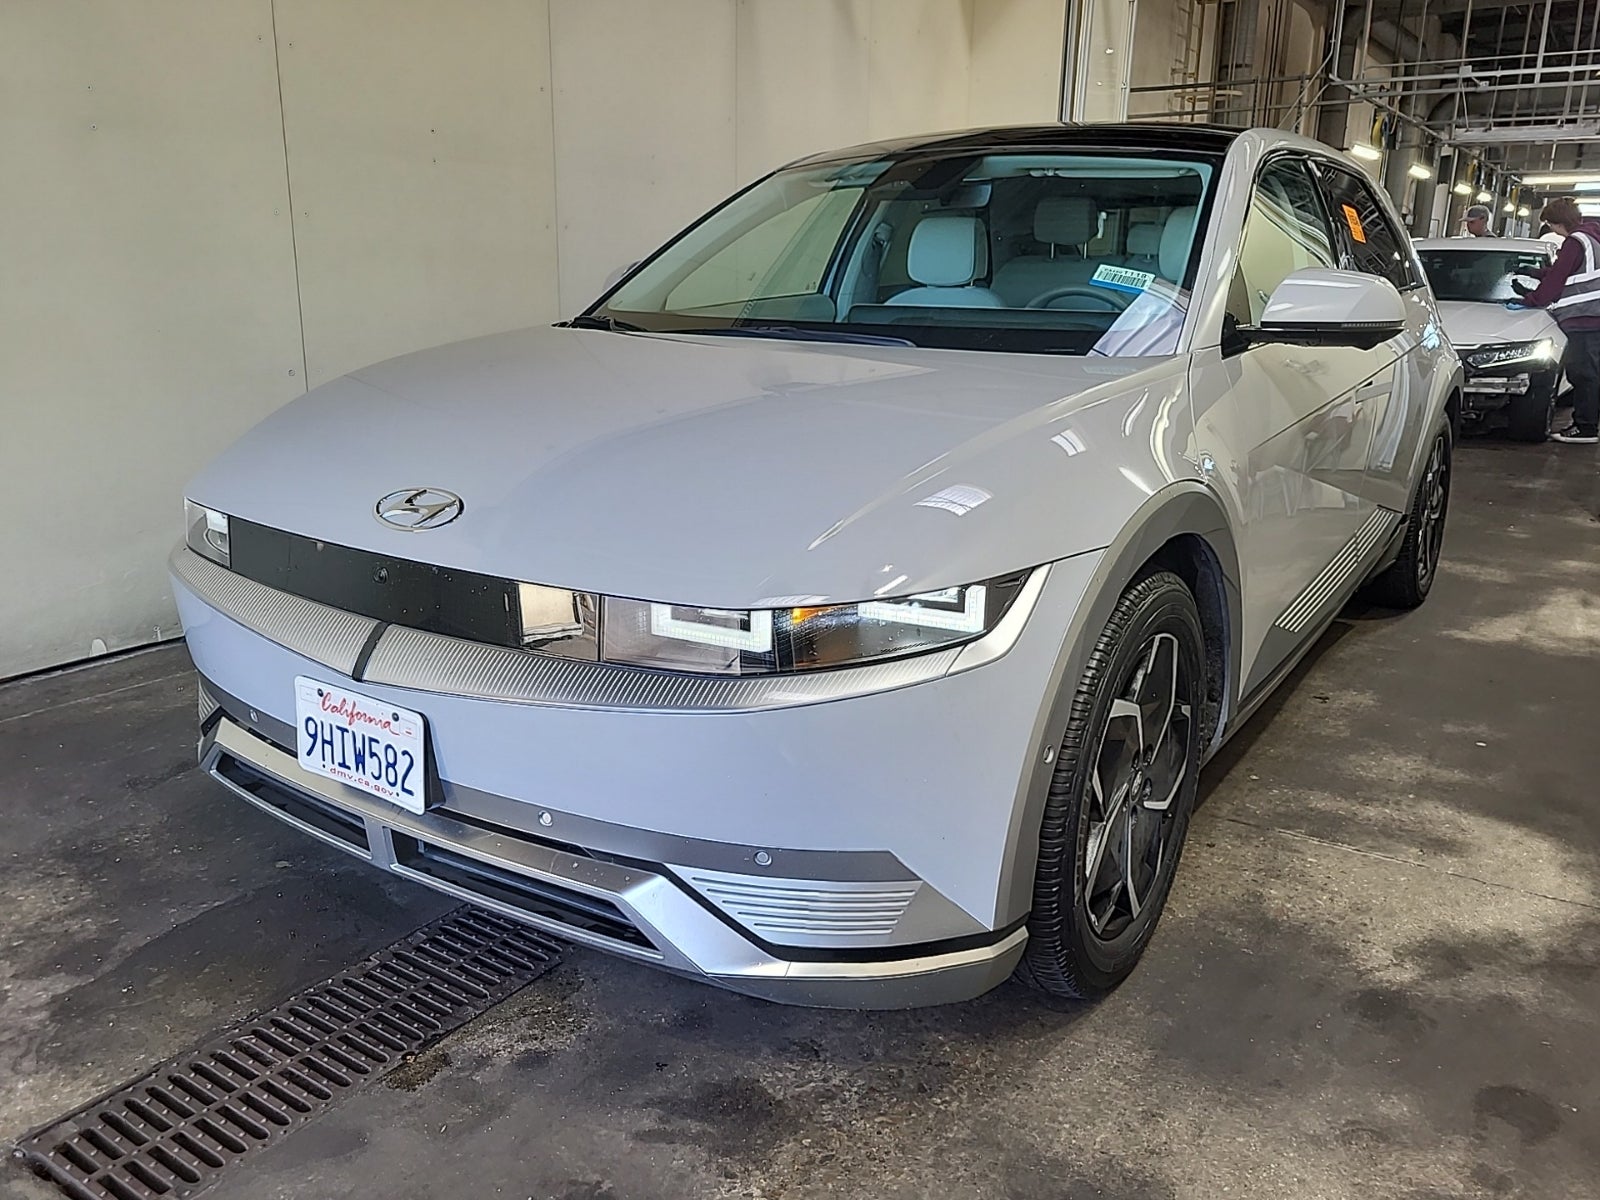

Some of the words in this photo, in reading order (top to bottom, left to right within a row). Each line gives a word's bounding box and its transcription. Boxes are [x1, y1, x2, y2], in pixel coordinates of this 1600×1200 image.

[321, 691, 401, 736] California
[304, 716, 415, 797] 9HIW582
[329, 767, 394, 797] dmv.ca.gov
